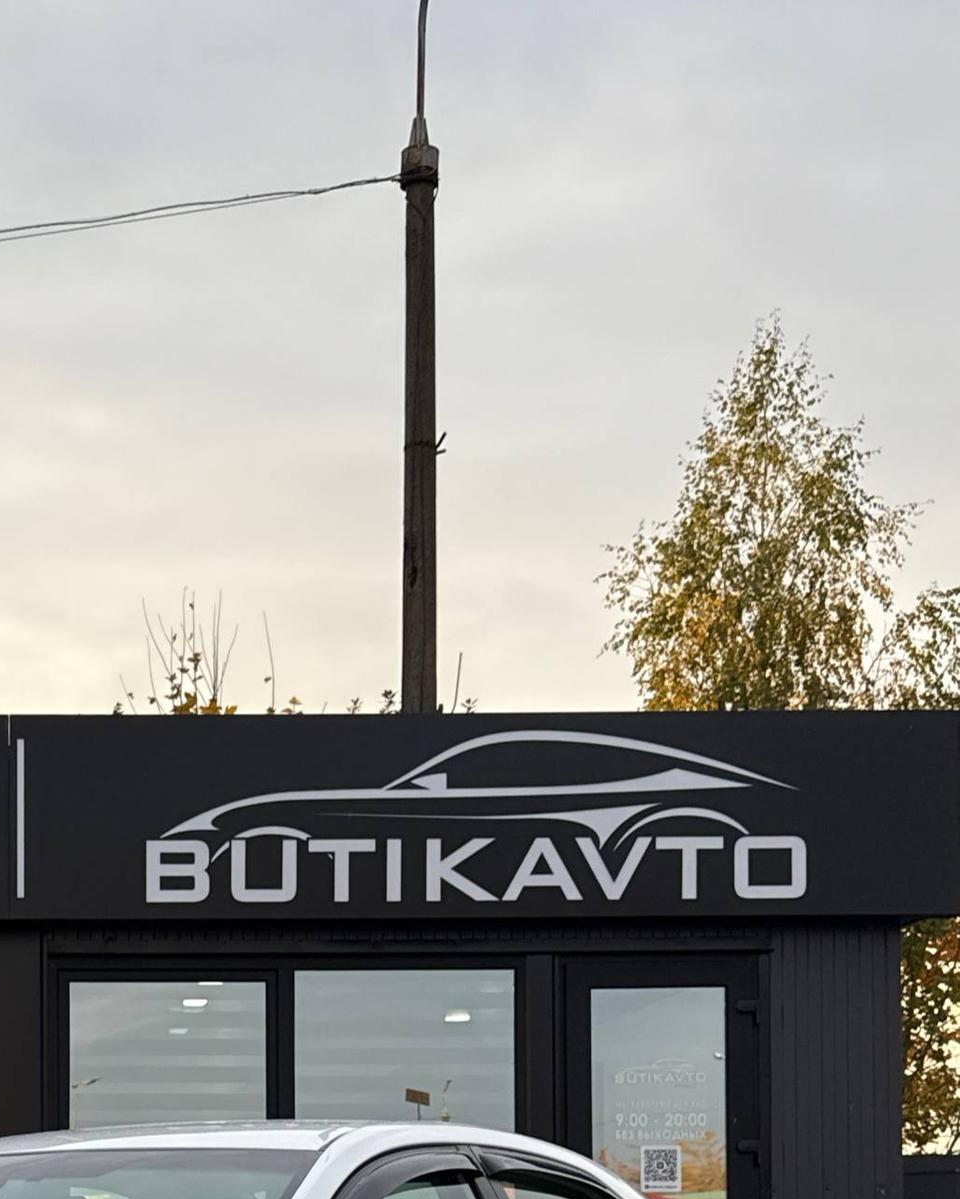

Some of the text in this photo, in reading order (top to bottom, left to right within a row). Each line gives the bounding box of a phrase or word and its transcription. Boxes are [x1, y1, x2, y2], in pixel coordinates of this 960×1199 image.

[146, 834, 808, 903] BUTIKAVTO
[615, 1073, 707, 1084] BUTIKAVTO
[615, 1113, 648, 1126] 9:00
[665, 1113, 707, 1126] 20:00
